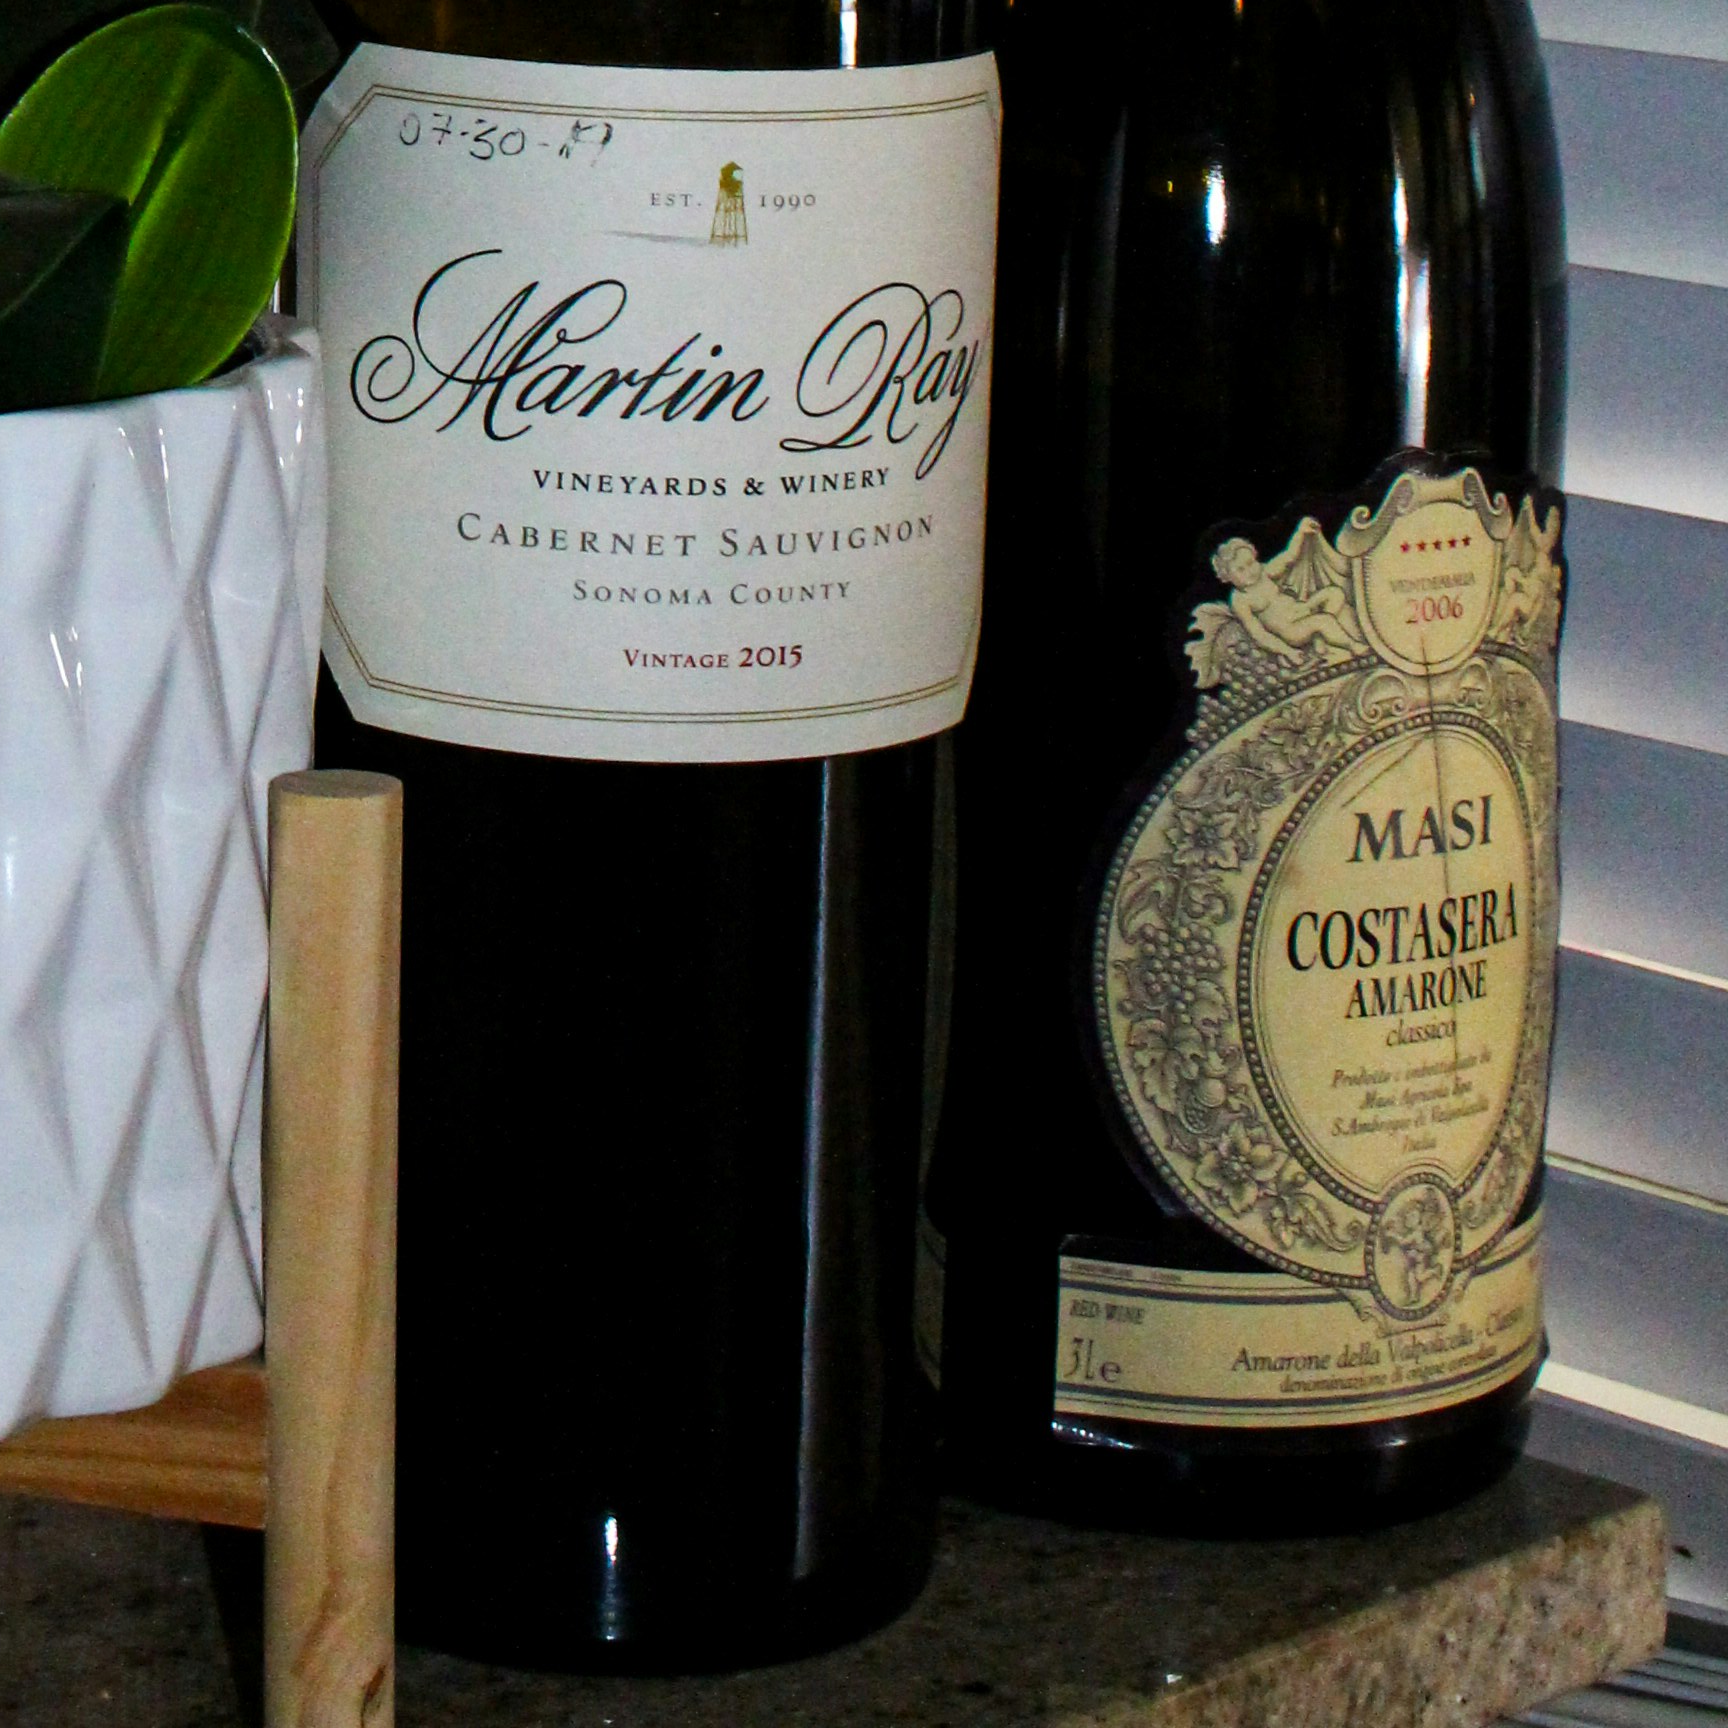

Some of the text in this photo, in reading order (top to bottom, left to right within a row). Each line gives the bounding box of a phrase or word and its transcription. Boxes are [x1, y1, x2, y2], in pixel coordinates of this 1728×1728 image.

[650, 192, 817, 212] EST. 1990
[350, 248, 981, 481] Martin Ray
[532, 467, 890, 497] VINEYARDS & WINERY
[456, 513, 934, 559] CABERNET SAUVIGNON
[571, 579, 852, 606] SONOMA COUNTY
[1405, 595, 1464, 625] 2006
[623, 645, 804, 669] VINTAGE 2015
[1345, 793, 1493, 864] MASI
[1286, 881, 1518, 972] COSTASERA
[1344, 959, 1487, 1020] AMARONE
[1231, 1347, 1331, 1372] Amarone
